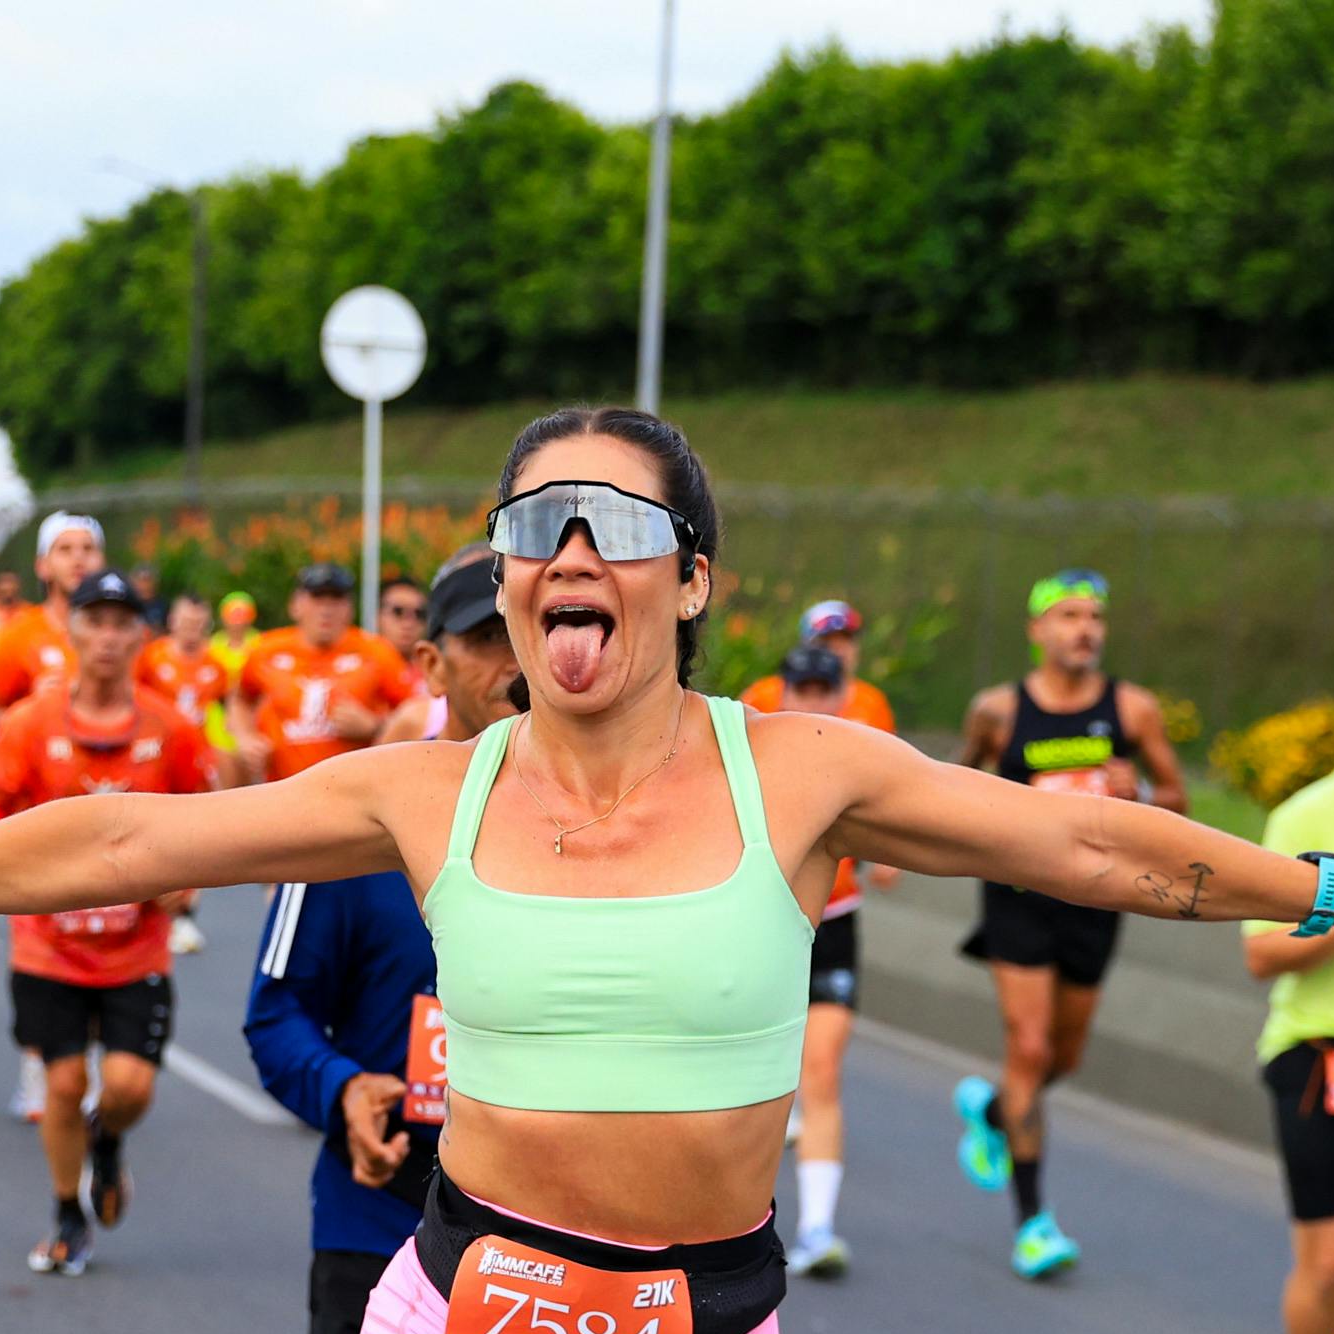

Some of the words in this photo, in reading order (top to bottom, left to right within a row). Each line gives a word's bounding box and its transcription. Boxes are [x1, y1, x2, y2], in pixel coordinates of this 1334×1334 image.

[563, 496, 595, 505] 100%
[493, 1254, 565, 1280] MMCAFÉ
[633, 1279, 676, 1308] 21K
